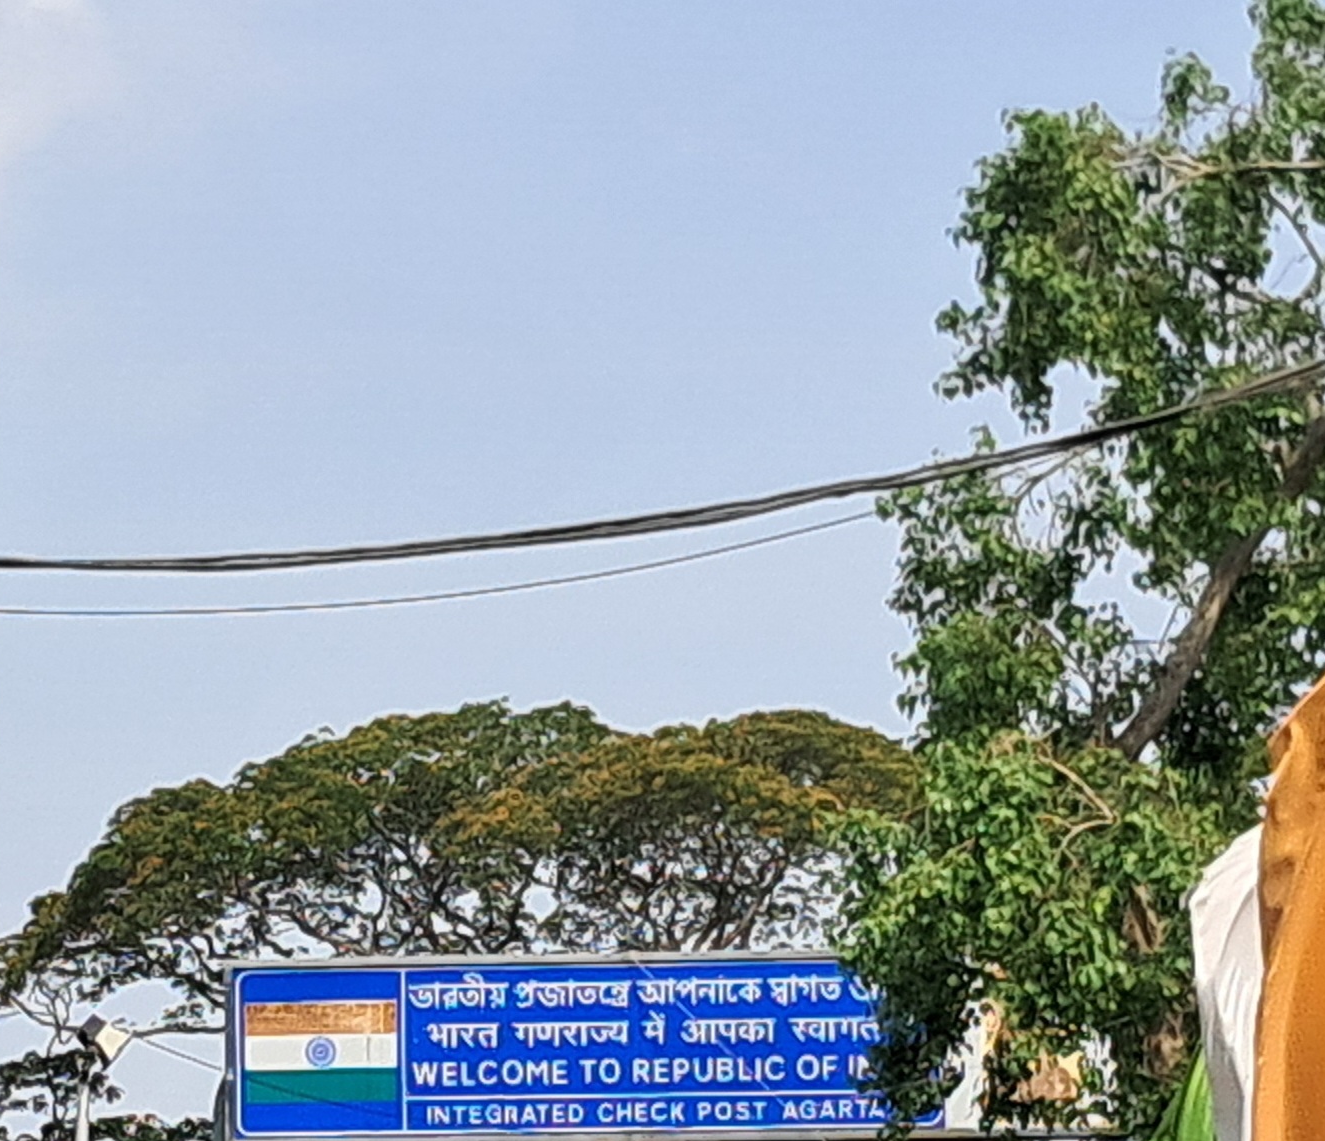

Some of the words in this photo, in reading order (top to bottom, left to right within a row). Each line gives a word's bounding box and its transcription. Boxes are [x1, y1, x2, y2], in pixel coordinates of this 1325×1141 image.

[408, 972, 509, 1010] ভারতীয়
[637, 975, 763, 1006] আপনাকে
[425, 1022, 499, 1048] भारत
[511, 1019, 630, 1048] गणराज्य
[641, 1009, 666, 1044] में
[680, 1017, 776, 1044] आपका
[412, 1058, 569, 1087] WELCOME
[579, 1058, 621, 1084] TO
[632, 1054, 786, 1084] REPUBLIC
[796, 1054, 838, 1082] OF
[426, 1102, 584, 1125] INTEGRATED
[596, 1101, 686, 1124] CHECK
[697, 1100, 767, 1121] POST
[782, 1098, 894, 1121] AGARTA
